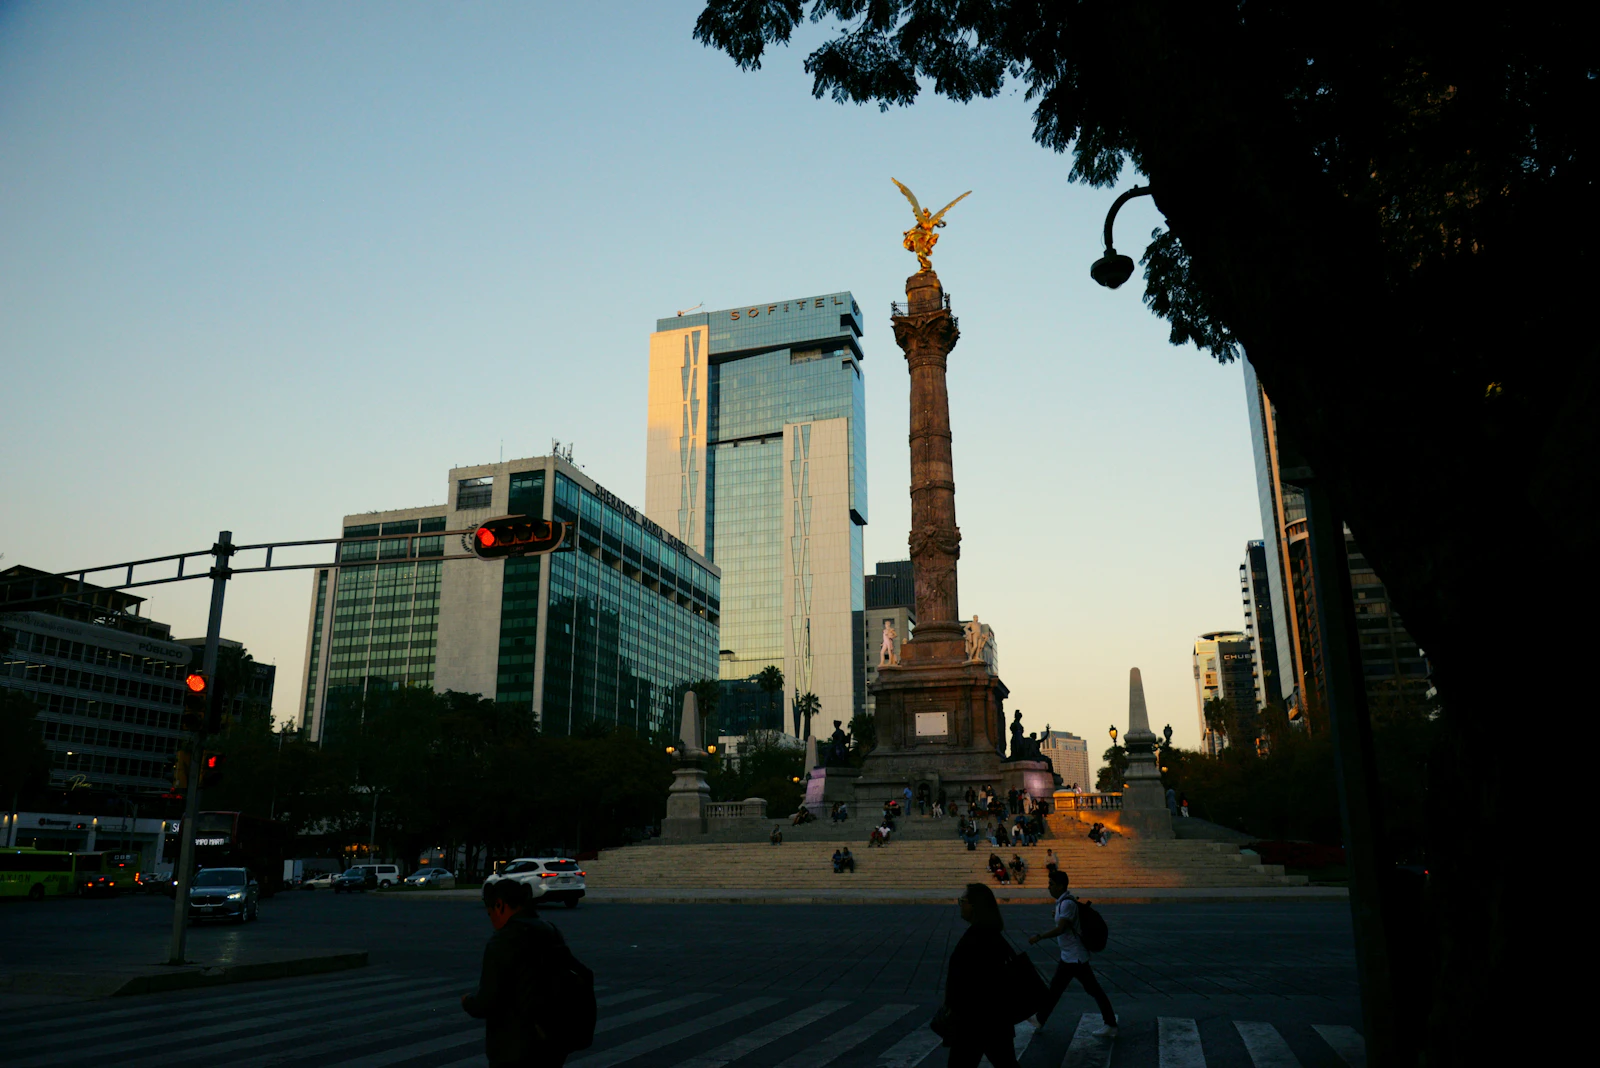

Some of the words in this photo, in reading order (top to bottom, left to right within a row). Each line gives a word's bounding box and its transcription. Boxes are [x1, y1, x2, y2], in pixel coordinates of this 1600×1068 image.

[730, 296, 843, 320] SOFITEL
[595, 483, 637, 521] SHERATON
[641, 516, 664, 540] MARIA
[667, 532, 688, 557] ISABEL
[138, 642, 183, 659] PÚBLICO
